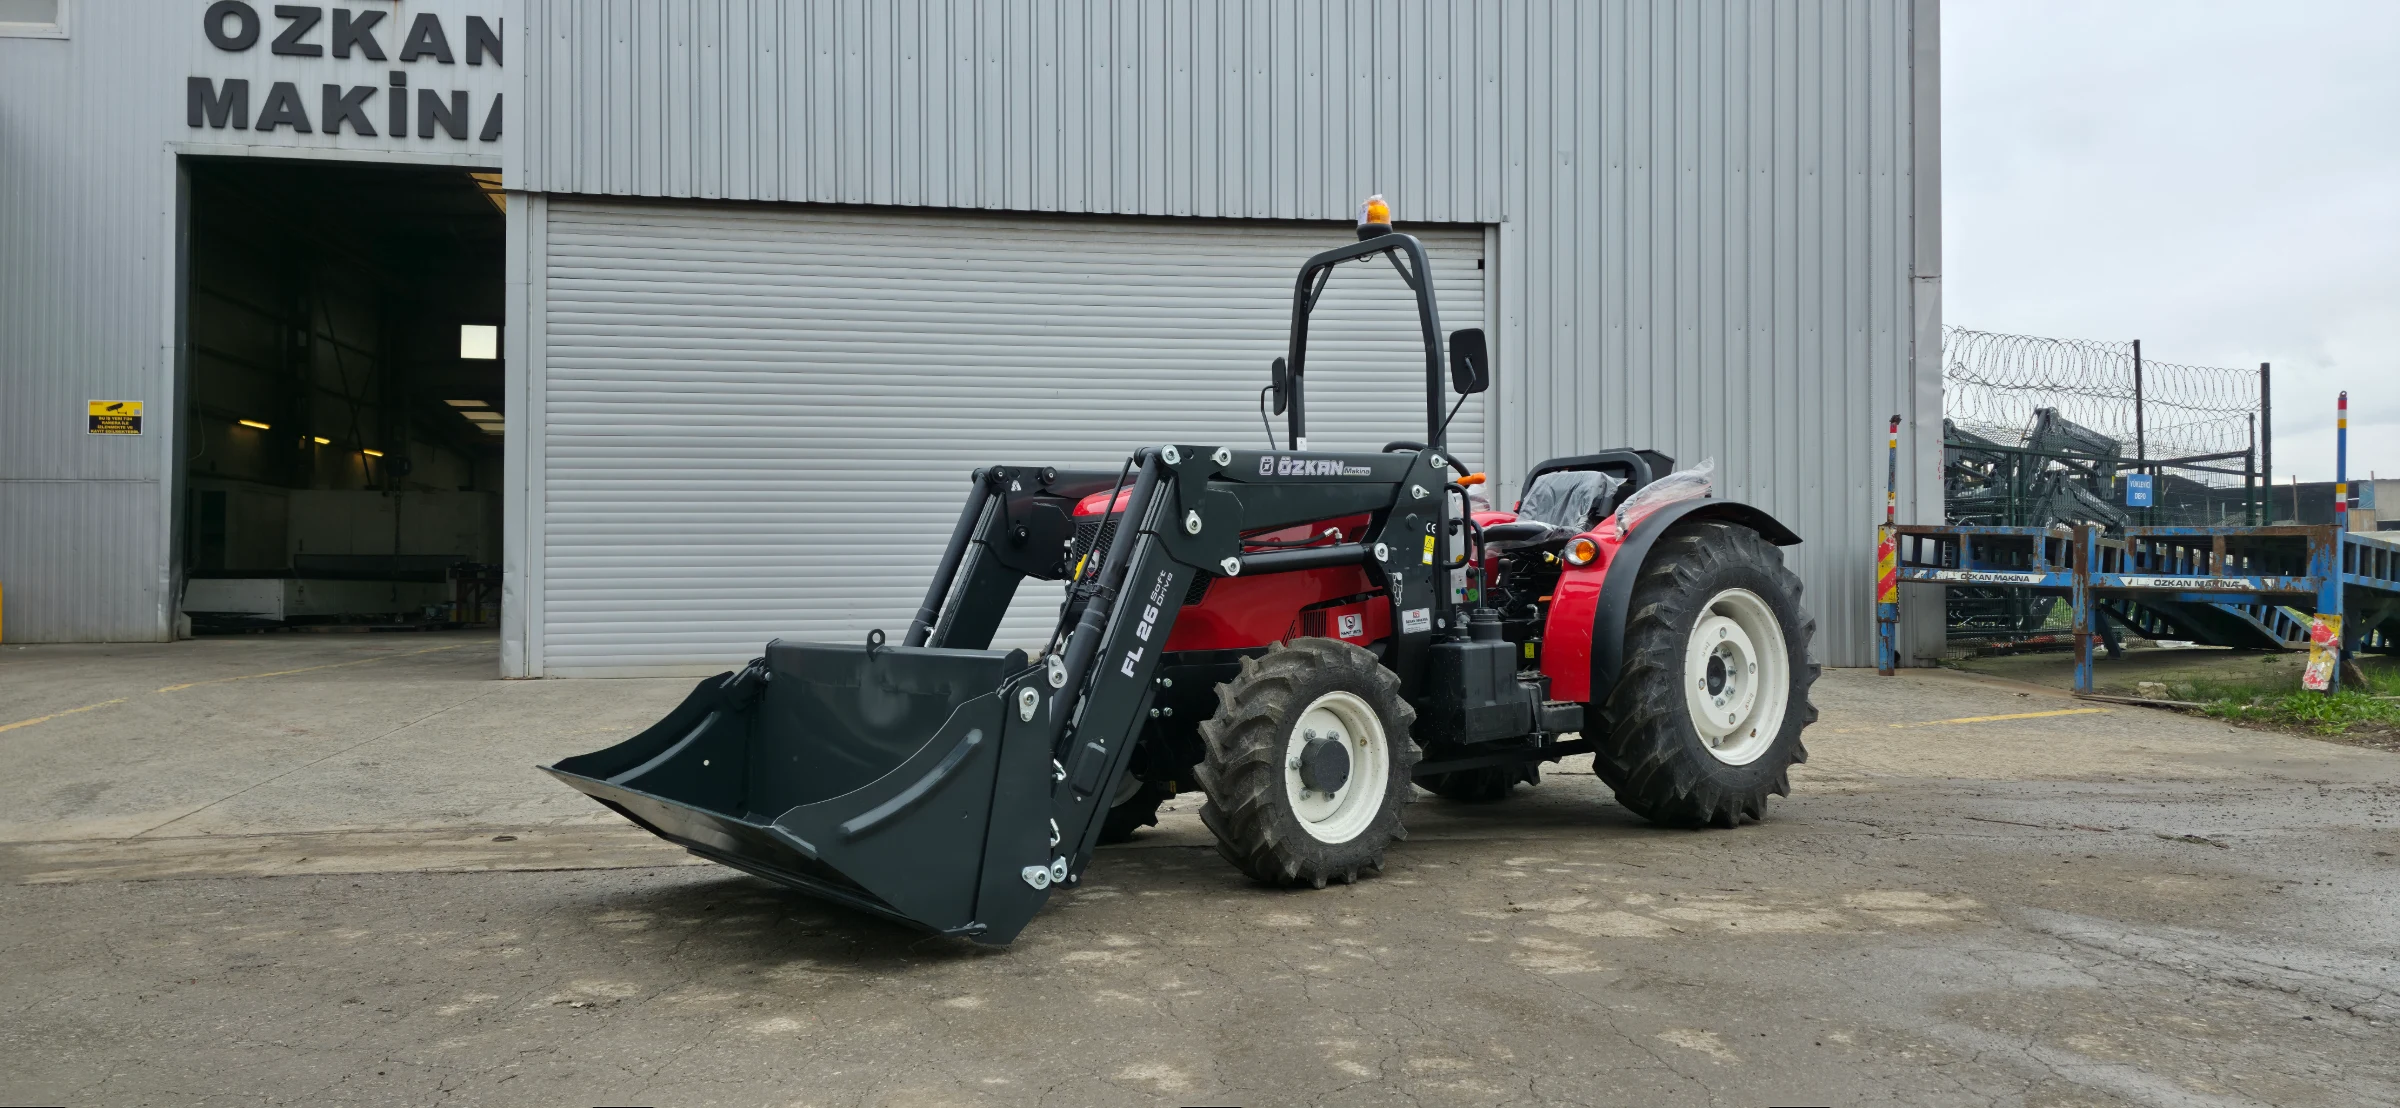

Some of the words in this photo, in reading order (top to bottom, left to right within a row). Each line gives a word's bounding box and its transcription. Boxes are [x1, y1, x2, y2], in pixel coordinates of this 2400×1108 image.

[1278, 456, 1344, 476] ÖZKAN
[2134, 492, 2147, 500] DEPO
[1150, 569, 1167, 602] Soft
[1156, 572, 1174, 607] Drive
[1121, 646, 1144, 678] FL
[1135, 603, 1160, 642] 26
